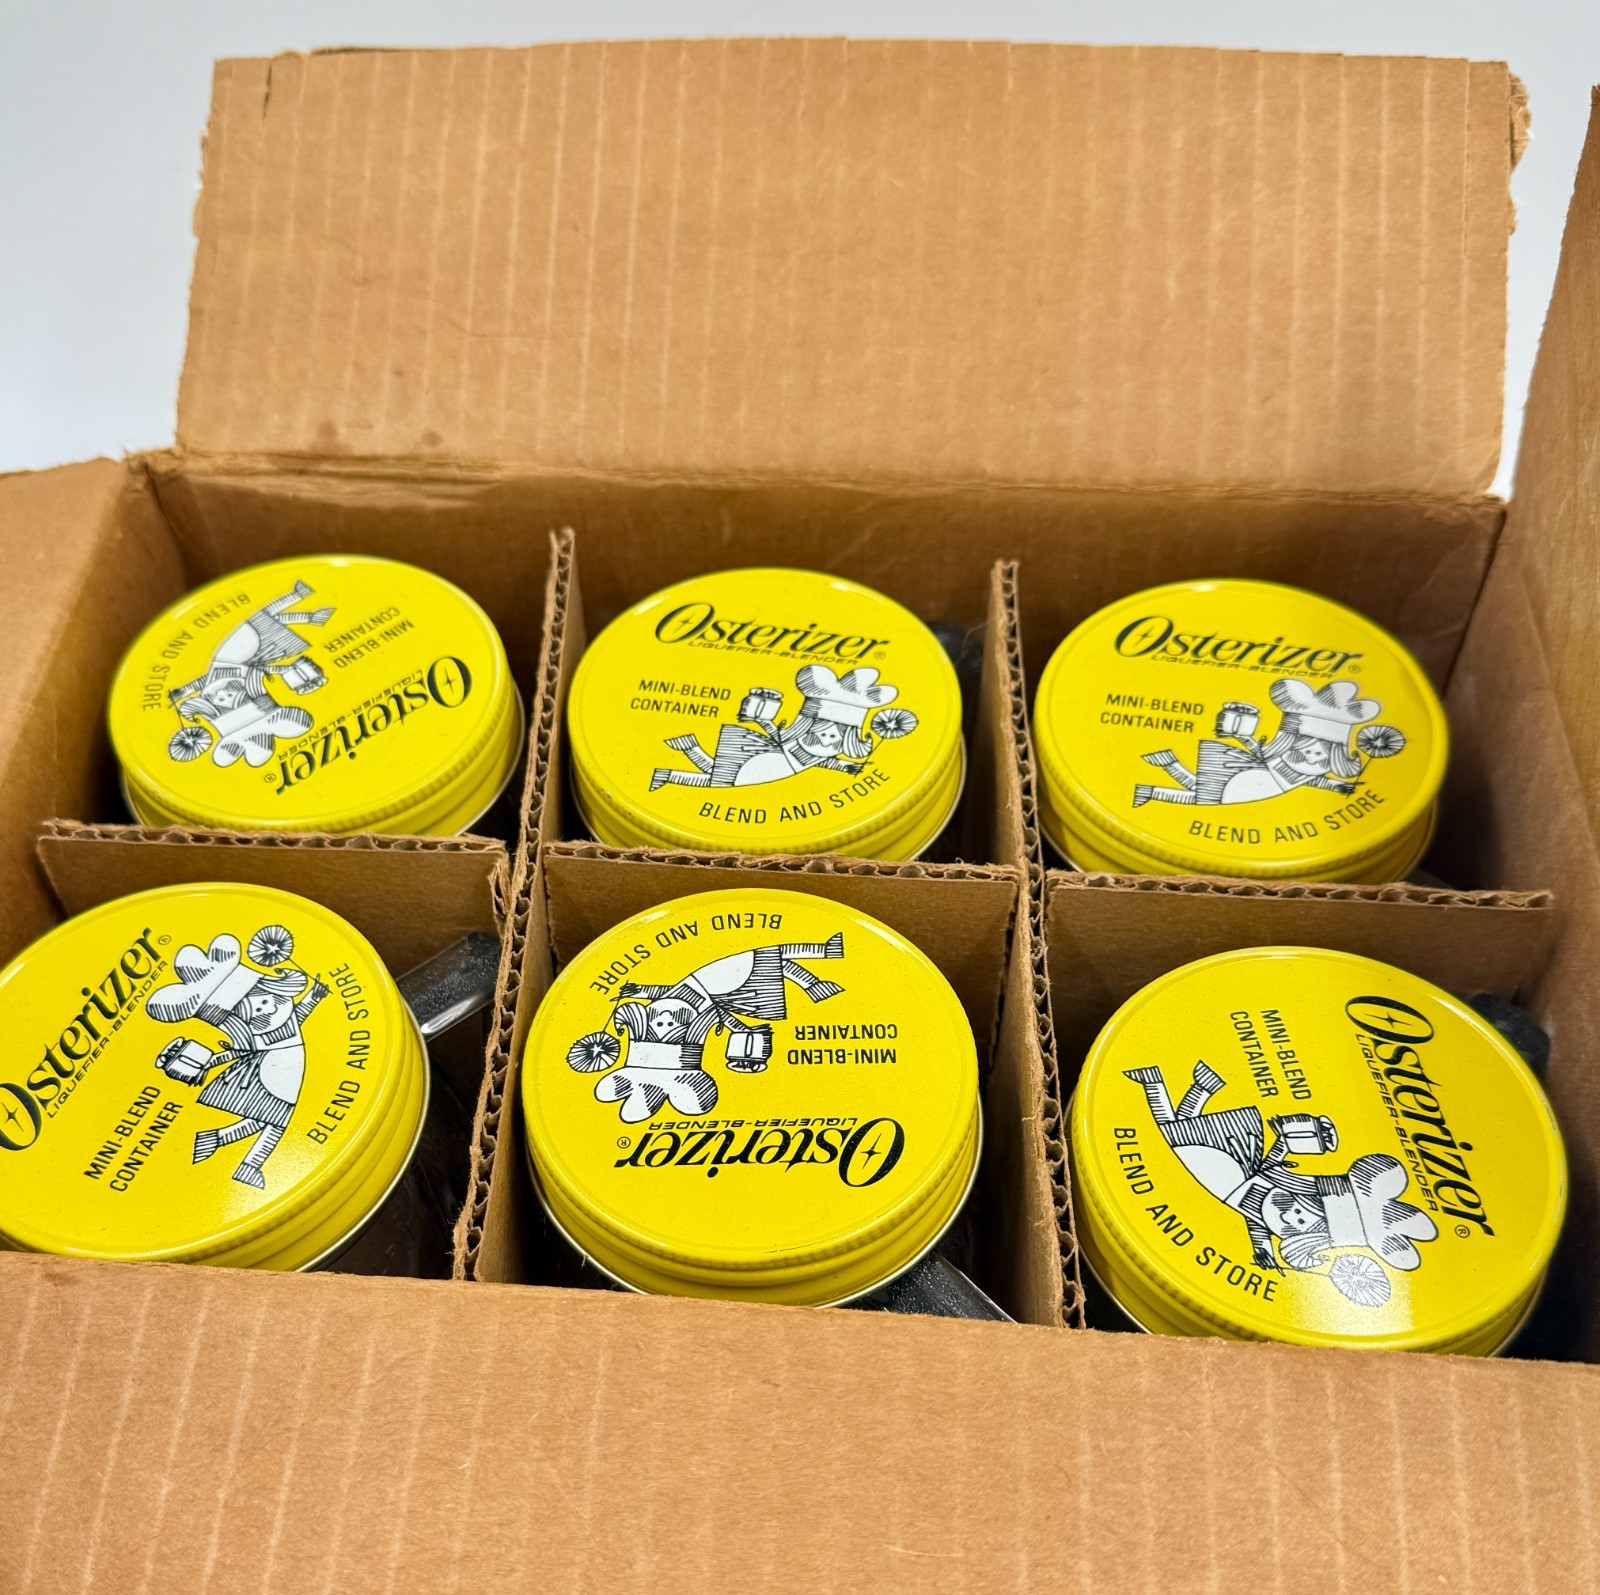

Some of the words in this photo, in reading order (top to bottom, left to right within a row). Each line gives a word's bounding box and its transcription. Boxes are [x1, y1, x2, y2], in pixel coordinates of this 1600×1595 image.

[193, 592, 251, 629] BLEND
[323, 607, 401, 654] CONTAINER
[160, 631, 195, 660] AND
[333, 620, 415, 669] MINI-BLEND
[688, 641, 859, 665] LIQUEFIER-BLENDER
[1150, 654, 1335, 679] LIQUEFIER-BLENDER
[142, 664, 172, 712] STORE
[630, 698, 720, 718] CONTAINER
[638, 679, 731, 701] MINI-BLEND
[1106, 693, 1204, 716] MINI-BLEND
[278, 669, 424, 761] LIQUEFIER-BLENDER
[1100, 712, 1194, 734] CONTAINER
[699, 802, 767, 824] BLEND
[779, 801, 822, 823] AND
[829, 769, 890, 809] STORE
[1188, 820, 1261, 845] BLEND
[1274, 821, 1319, 843] AND
[1323, 789, 1385, 831] STORE
[655, 920, 698, 949] AND
[711, 913, 782, 930] BLEND
[328, 962, 369, 1020] STORE
[589, 944, 651, 996] STORE
[46, 960, 168, 1119] LIQUEFIER-BLENDER
[348, 1030, 371, 1070] AND
[795, 1023, 898, 1041] CONTAINER
[1230, 1010, 1278, 1099] CONTAINER
[1260, 1009, 1312, 1100] MINI-BLEND
[787, 1048, 897, 1066] MINI-BLEND
[83, 1085, 161, 1180] MINI-BLEND
[306, 1080, 361, 1145] BLEND
[648, 1117, 858, 1132] LIQUEFIER-BLENDER
[1355, 1036, 1440, 1211] LIQUEFIER-BLENDER
[109, 1101, 184, 1193] CONTAINER
[1114, 1127, 1153, 1195] BLEND
[1146, 1204, 1194, 1247] AND
[1196, 1245, 1279, 1302] STORE
